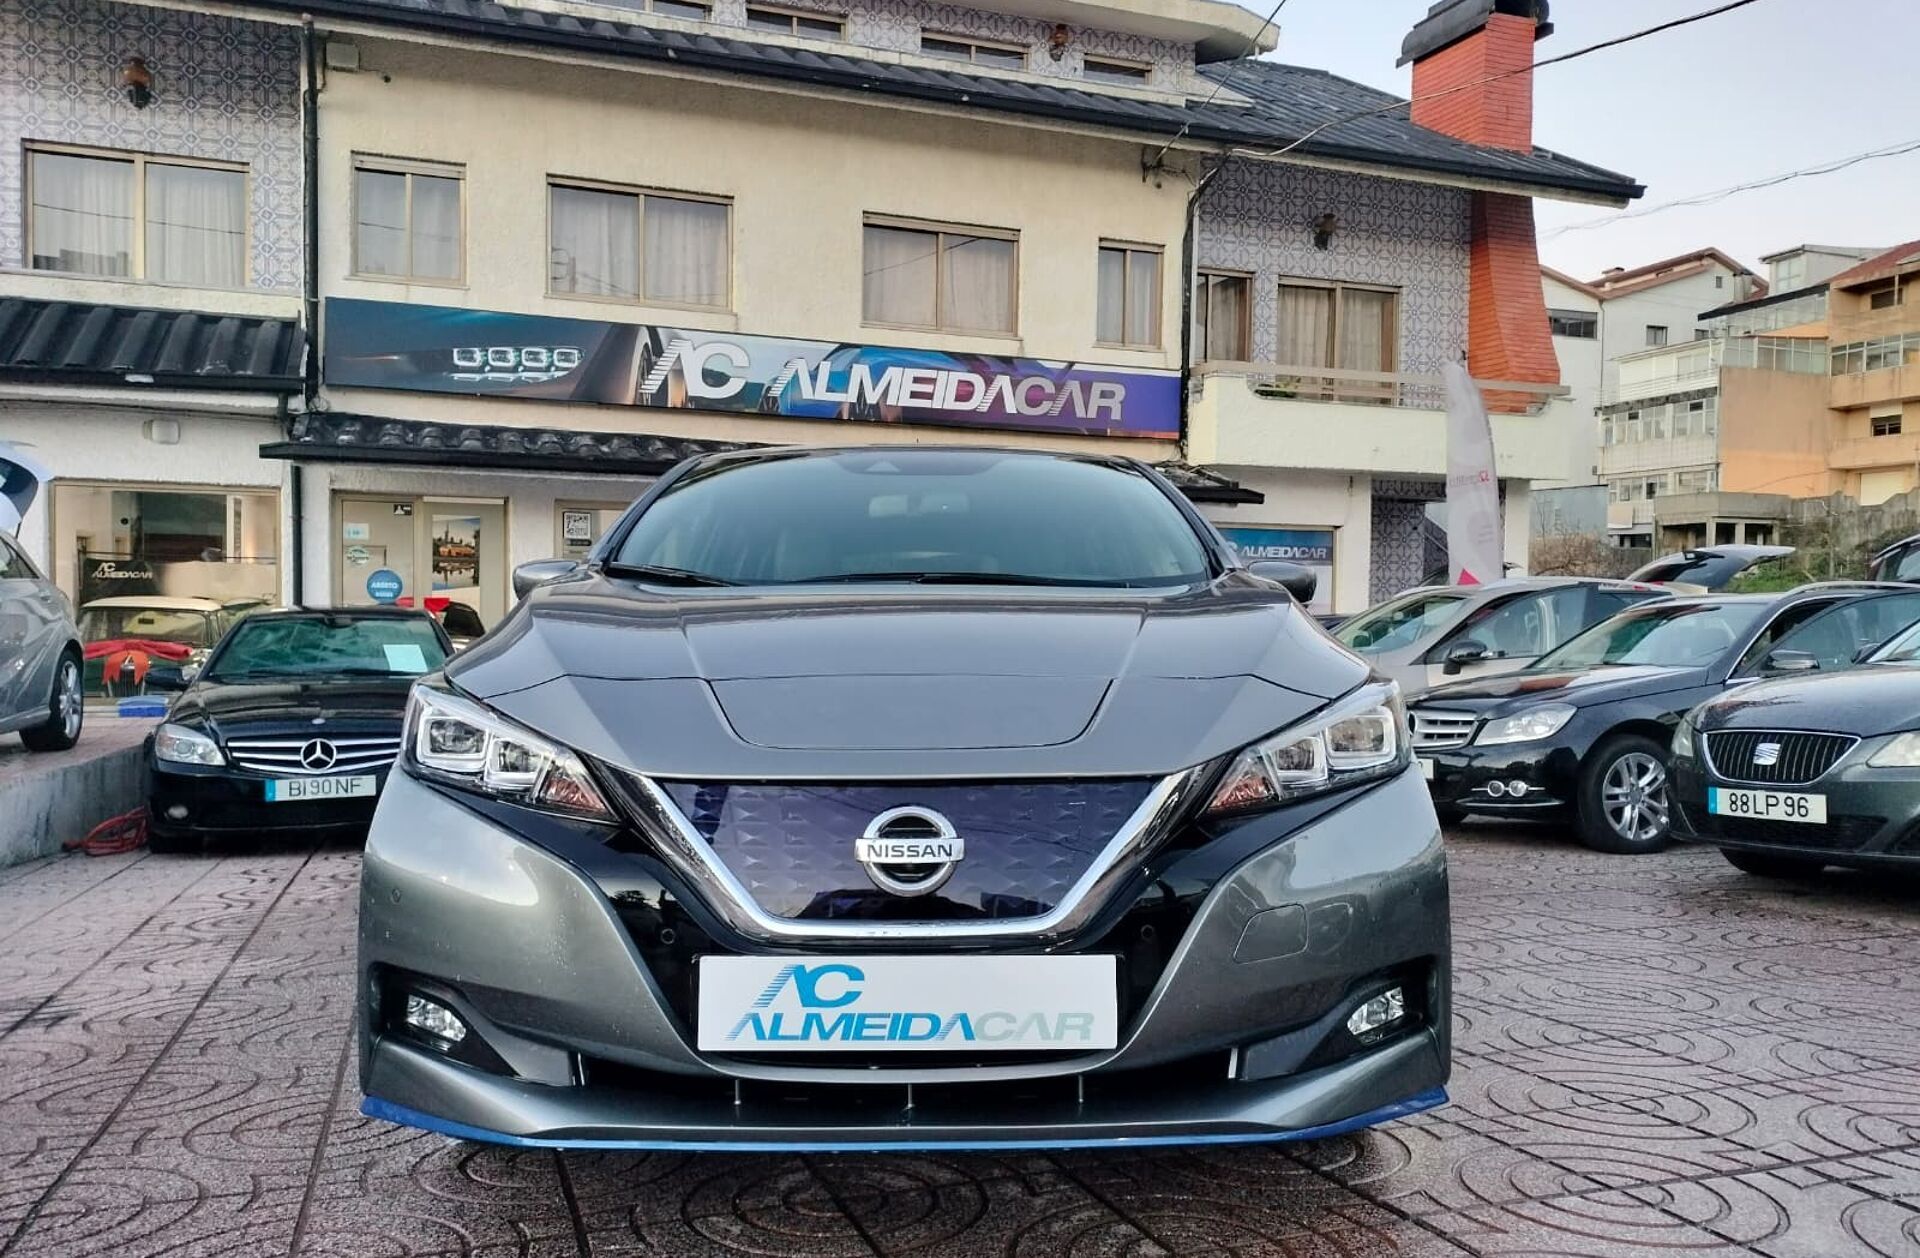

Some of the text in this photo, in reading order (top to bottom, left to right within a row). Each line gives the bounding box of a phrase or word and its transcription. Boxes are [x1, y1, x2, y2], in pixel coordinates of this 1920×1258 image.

[638, 338, 1126, 421] AC ALMEIDACAR
[1240, 545, 1327, 559] ALMEIDACAR
[867, 844, 953, 858] NISSAN
[751, 963, 865, 1009] AC
[722, 1012, 1096, 1042] ALMEIDACAR
